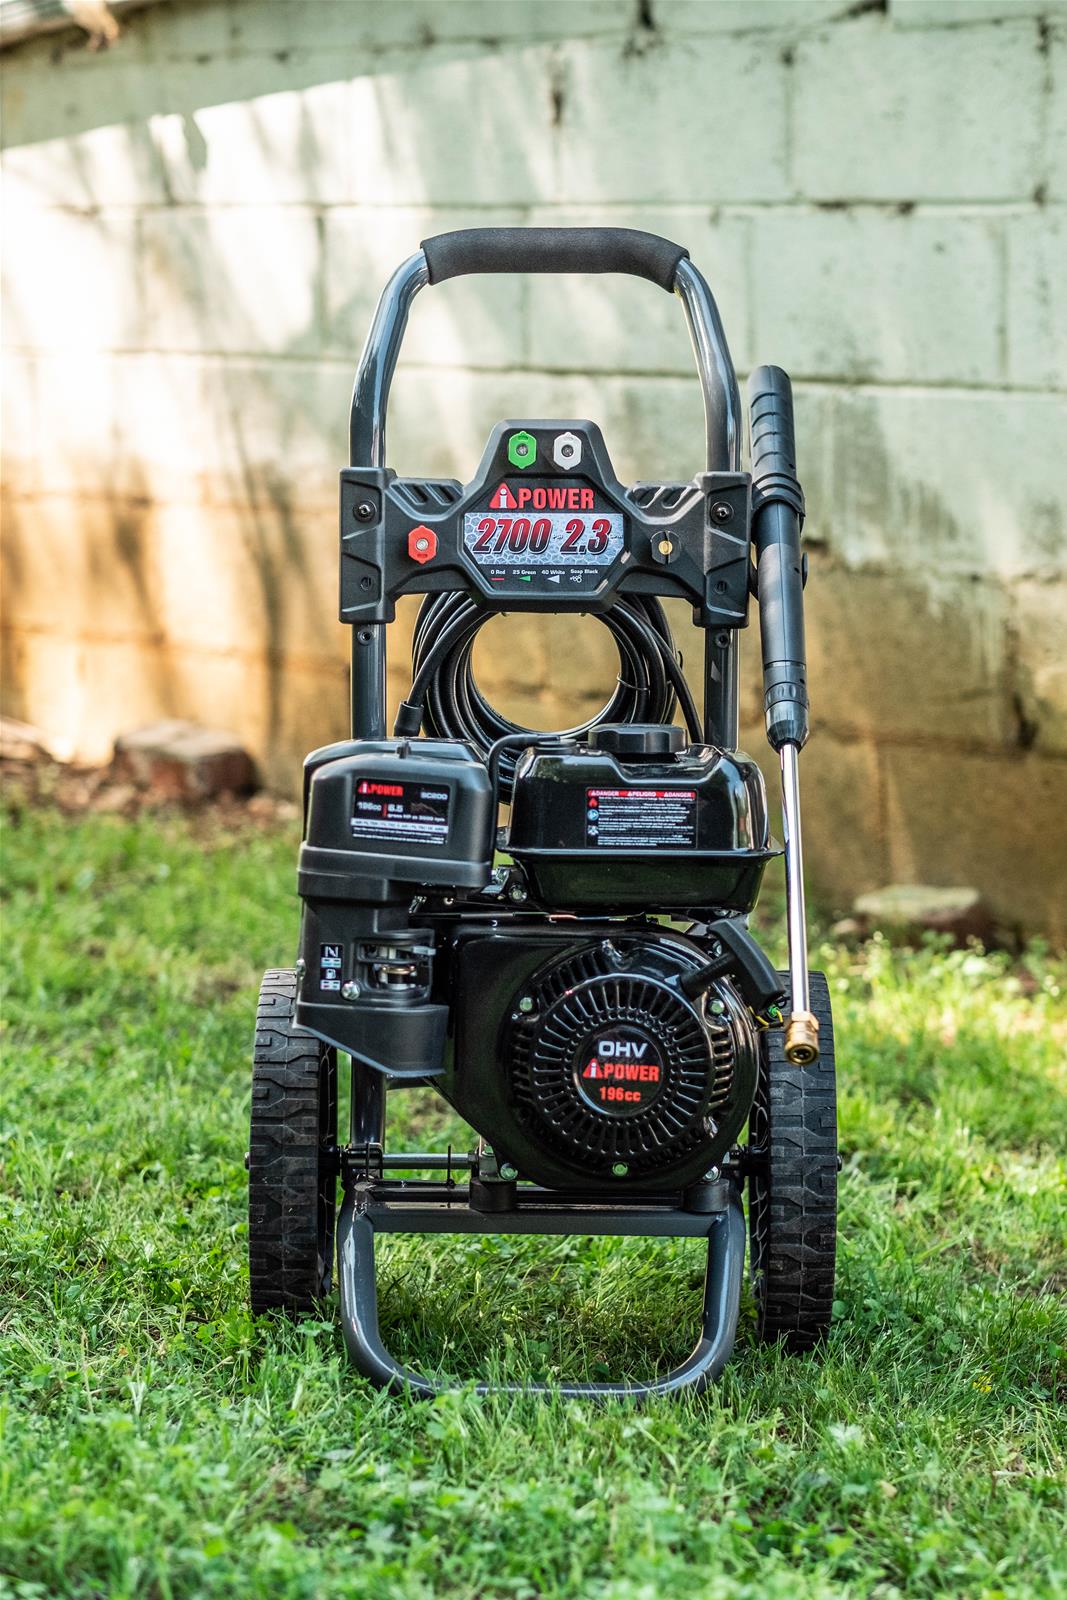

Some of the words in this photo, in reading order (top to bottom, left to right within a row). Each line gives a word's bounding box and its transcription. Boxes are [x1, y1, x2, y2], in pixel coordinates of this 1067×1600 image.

[472, 517, 553, 555] 2700
[560, 517, 611, 555] 2.3
[598, 1040, 648, 1058] OHV
[599, 1086, 642, 1103] 196cc
